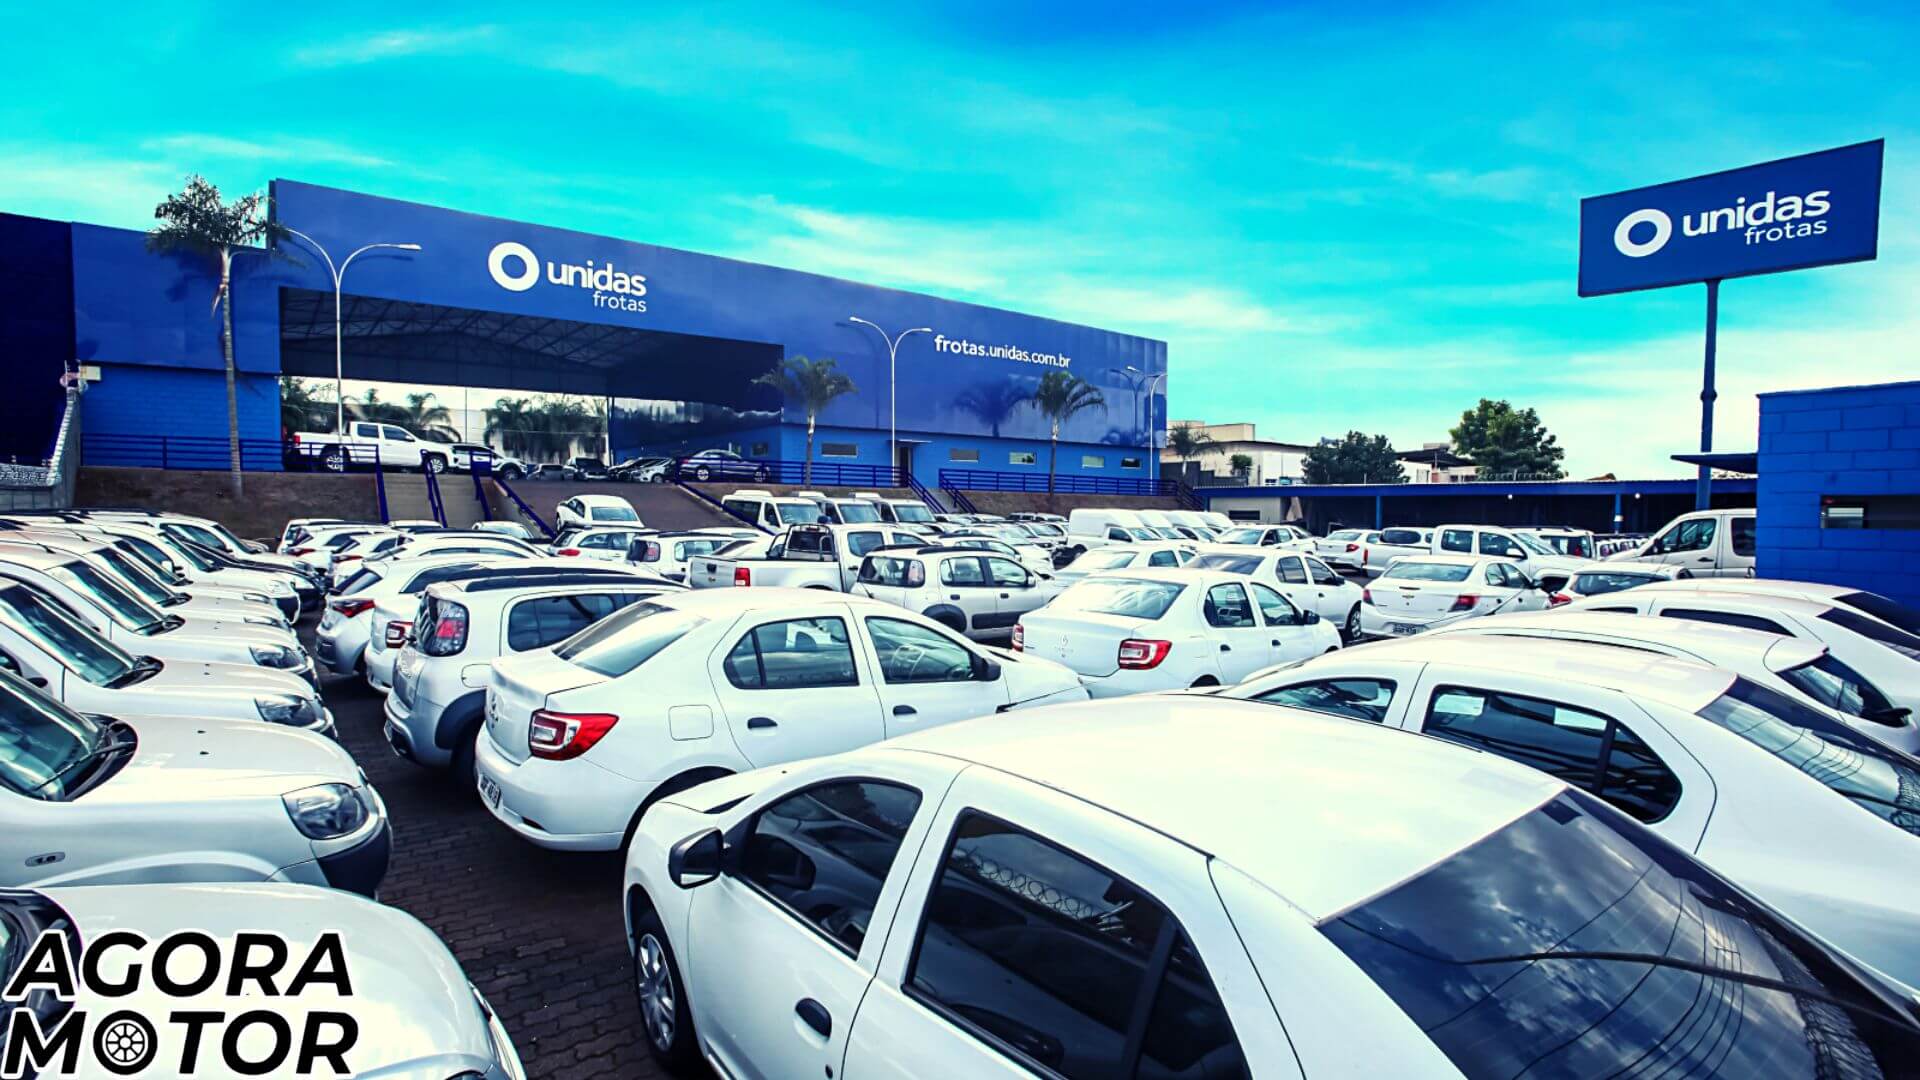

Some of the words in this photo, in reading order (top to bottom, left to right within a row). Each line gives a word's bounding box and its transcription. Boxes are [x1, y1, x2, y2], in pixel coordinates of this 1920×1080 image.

[1682, 190, 1831, 237] unidas
[1744, 219, 1828, 245] frotas
[547, 260, 647, 297] unidas
[592, 291, 647, 313] frotas
[934, 334, 1071, 368] frotas.unidas.com.br
